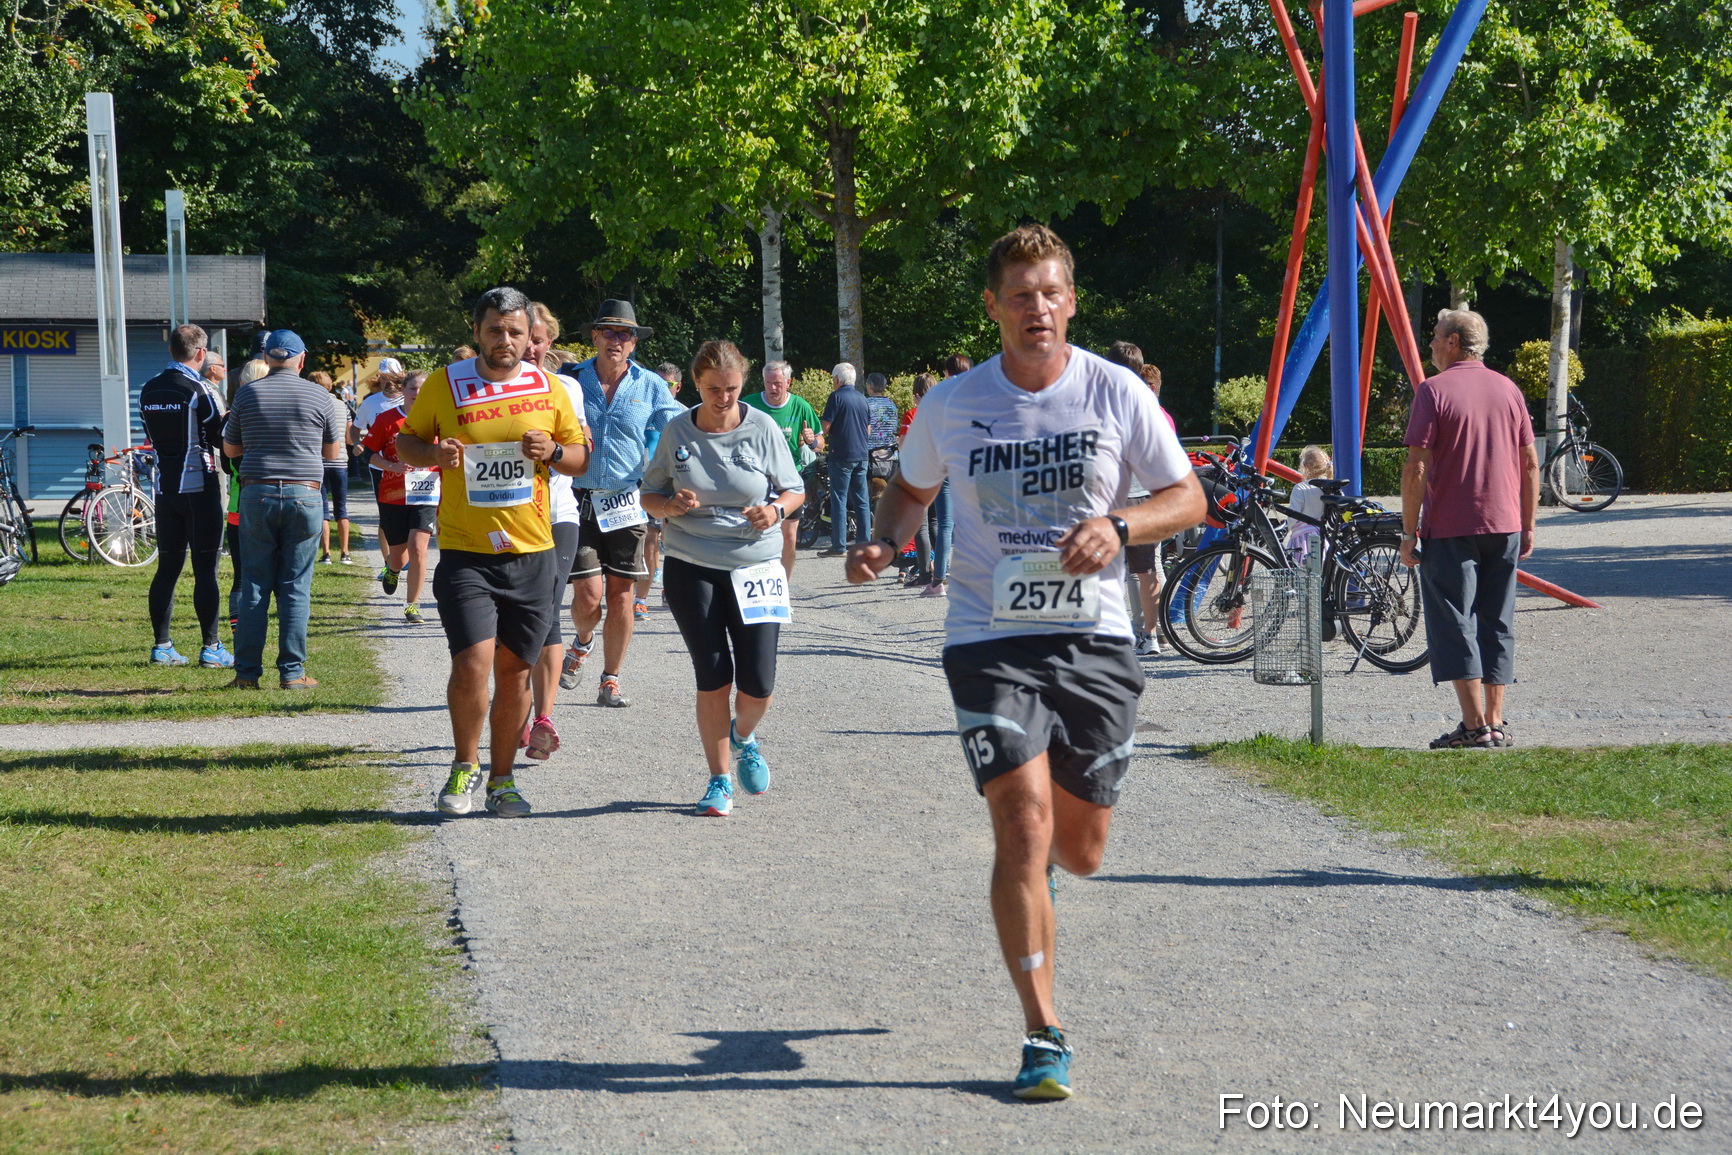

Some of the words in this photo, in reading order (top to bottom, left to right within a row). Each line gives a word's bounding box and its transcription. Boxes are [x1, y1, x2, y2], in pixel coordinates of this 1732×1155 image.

[2, 330, 71, 349] KIOSK
[457, 407, 504, 426] MAX
[508, 399, 554, 416] BÖGL
[484, 449, 515, 457] BOCK
[969, 430, 1099, 477] FINISHER
[476, 460, 525, 481] 2405
[1022, 462, 1085, 496] 2018
[411, 481, 435, 491] 2225
[489, 492, 515, 501] Ovidiu
[600, 491, 635, 512] 3000
[1023, 561, 1063, 573] BOC
[743, 578, 783, 599] 2126
[1009, 579, 1085, 611] 2574
[968, 729, 995, 769] 15
